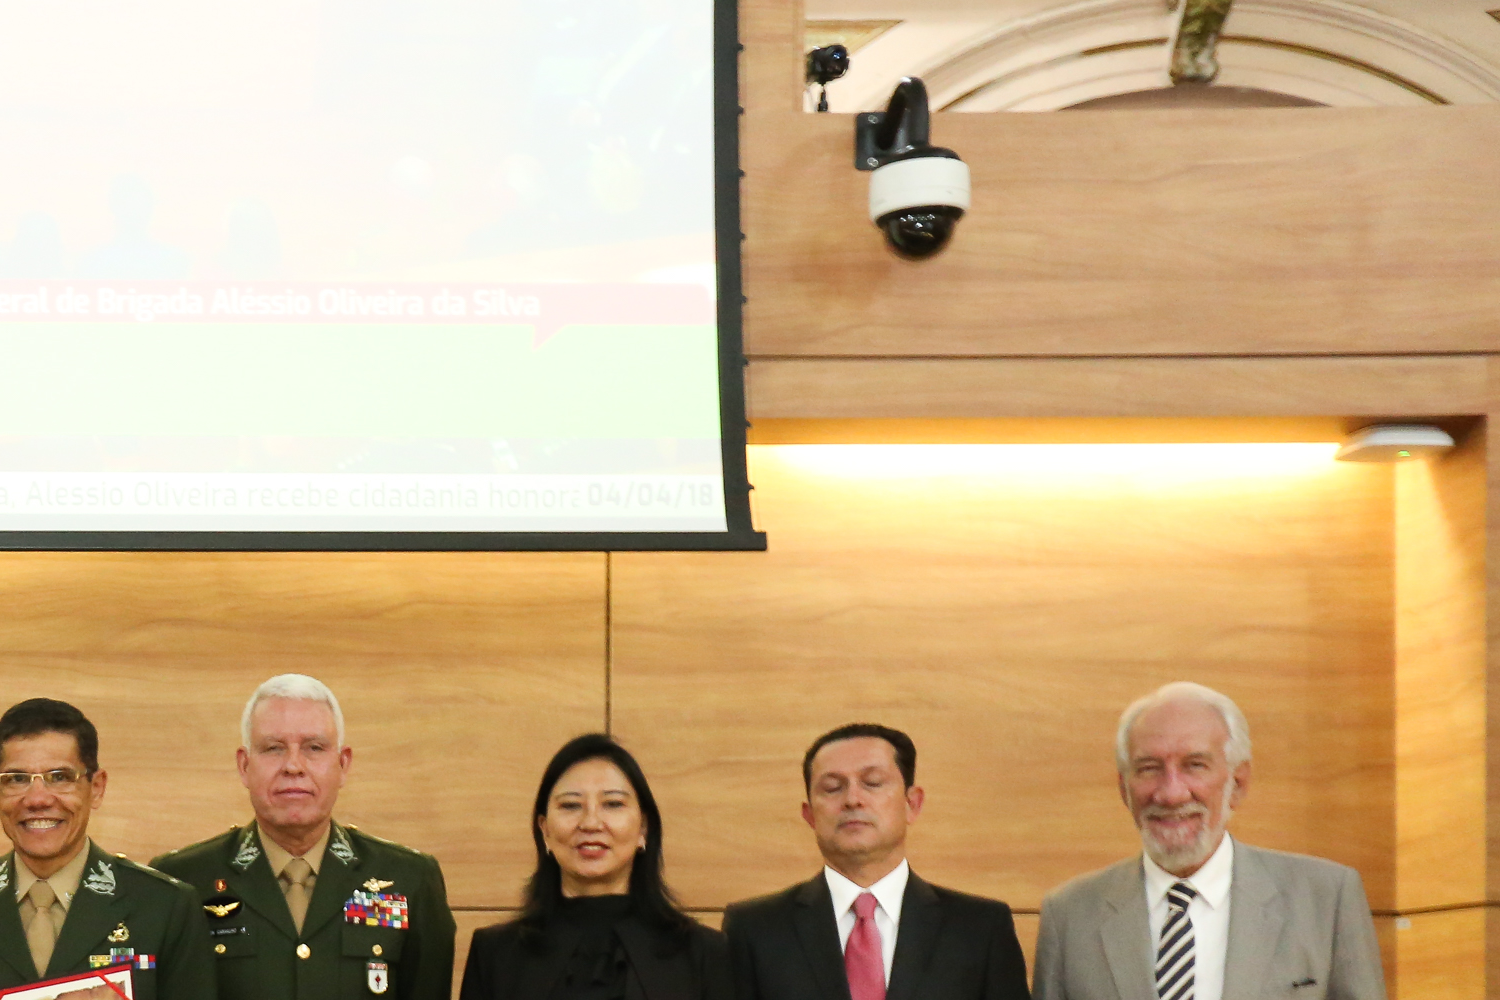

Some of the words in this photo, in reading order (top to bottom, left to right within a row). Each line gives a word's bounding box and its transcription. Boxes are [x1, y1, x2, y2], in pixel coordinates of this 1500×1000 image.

[55, 287, 90, 315] de
[97, 287, 202, 322] Brigada
[210, 287, 311, 316] Aléssio
[318, 288, 424, 316] Oliveira
[431, 289, 466, 316] da
[473, 289, 540, 316] Silva
[25, 480, 124, 507] Alessio
[133, 481, 238, 508] Oliveira
[248, 482, 340, 508] recebe
[349, 482, 478, 508] cidadania
[587, 481, 714, 509] 04/04/18
